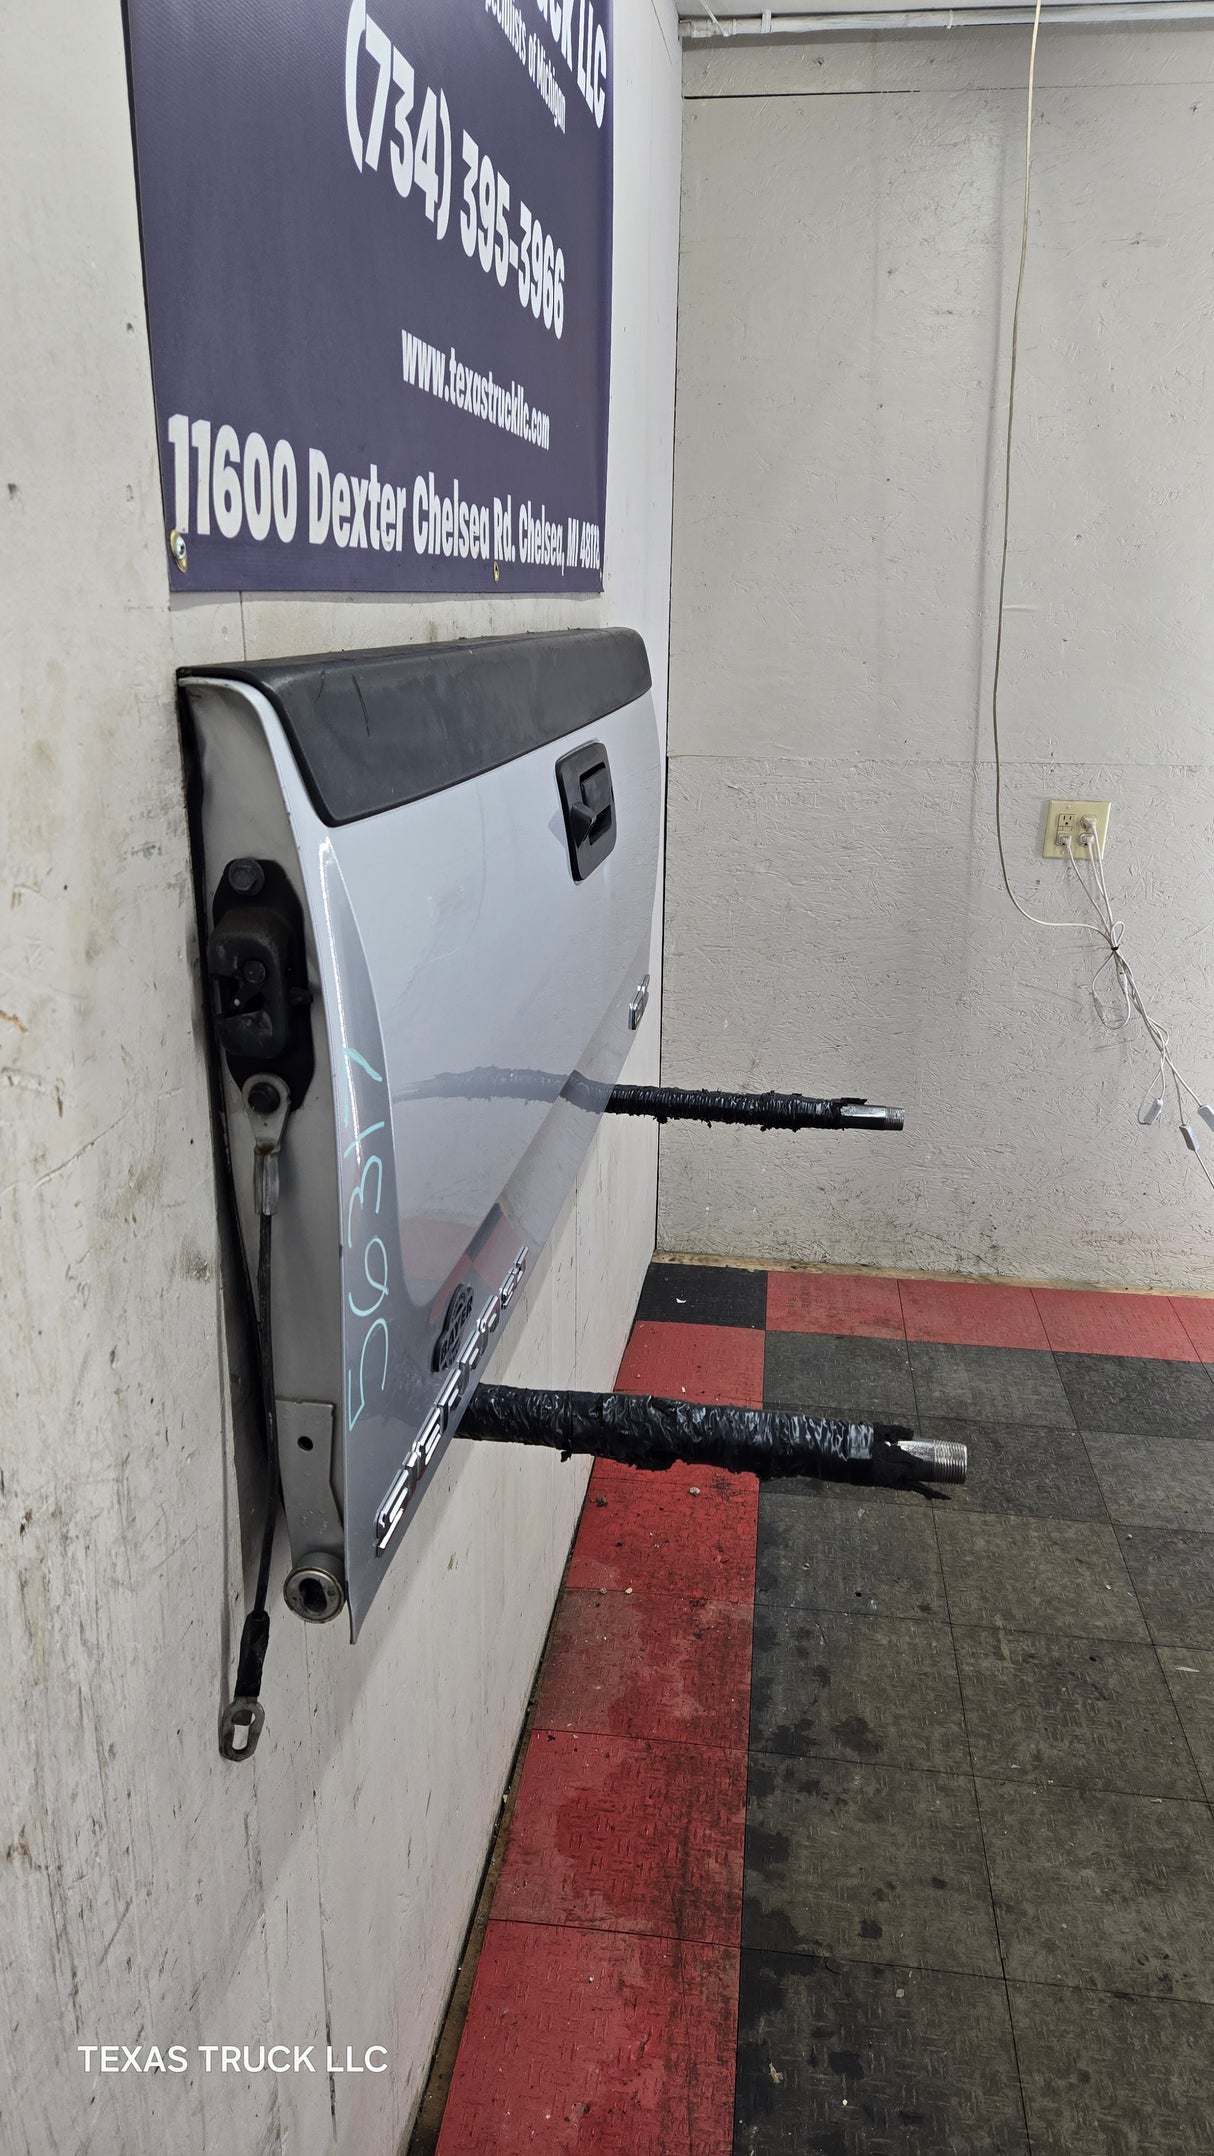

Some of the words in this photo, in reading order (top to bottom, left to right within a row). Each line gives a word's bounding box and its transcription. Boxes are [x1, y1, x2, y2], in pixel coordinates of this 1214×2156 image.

[528, 33, 537, 83] of
[536, 38, 566, 134] Michigan
[577, 0, 607, 128] LLC
[345, 0, 451, 240] (734)
[460, 129, 565, 339] 395-3966
[401, 329, 550, 451] www.texastruckllc.com
[168, 414, 297, 543] 11600
[308, 448, 406, 552] Dexter
[412, 471, 490, 560] Chelsea
[493, 494, 516, 563] Rd.
[518, 500, 565, 576] Chelsea,
[566, 517, 579, 568] MI
[343, 1047, 390, 1431] 56317
